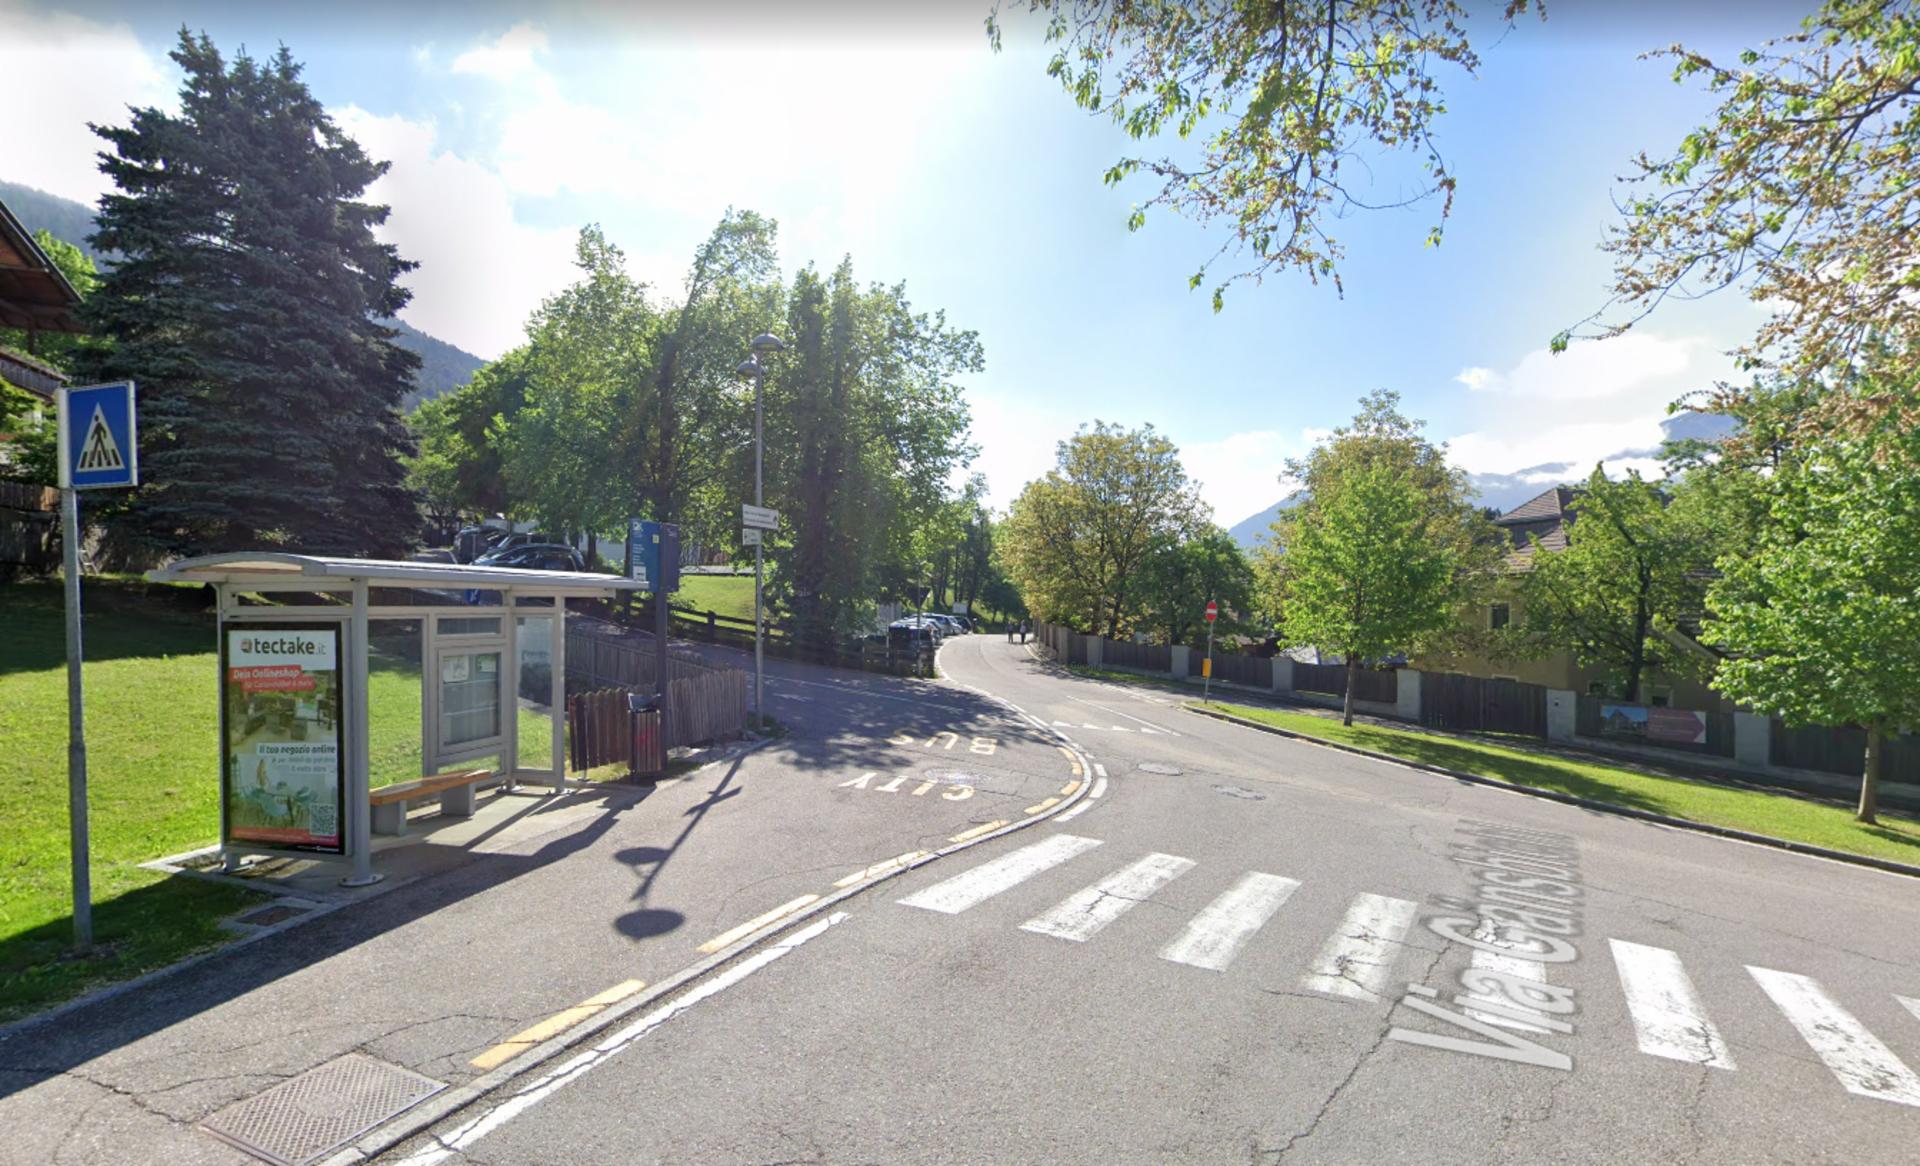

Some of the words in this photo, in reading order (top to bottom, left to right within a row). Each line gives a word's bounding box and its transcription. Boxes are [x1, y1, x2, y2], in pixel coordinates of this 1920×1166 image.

[254, 637, 327, 655] tectake.it
[280, 744, 310, 755] negozio
[311, 743, 336, 753] online
[883, 730, 998, 755] BUS
[838, 772, 976, 801] CITY
